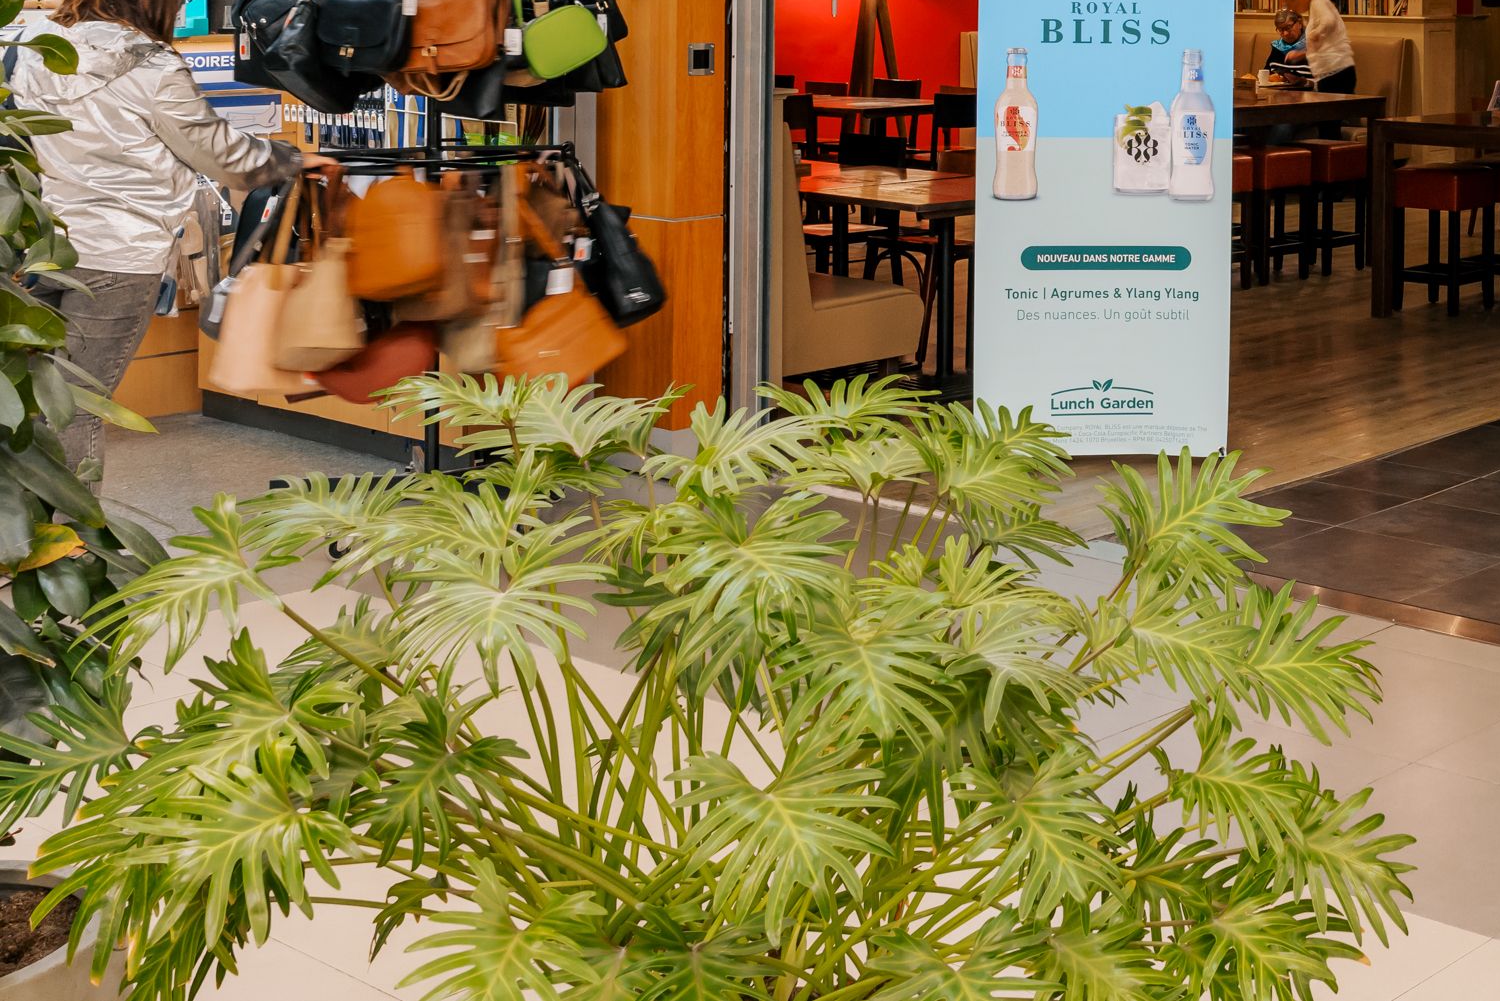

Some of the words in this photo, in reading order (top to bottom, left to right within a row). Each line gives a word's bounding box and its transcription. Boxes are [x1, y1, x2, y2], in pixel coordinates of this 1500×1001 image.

[1071, 1, 1141, 15] ROYAL
[1040, 18, 1171, 45] BLISS
[1000, 120, 1032, 128] BLISS
[1178, 131, 1209, 139] LISS
[1037, 254, 1081, 263] NOUVEAU
[1082, 254, 1108, 263] DANS
[1110, 254, 1140, 263] NOTRE
[1142, 254, 1176, 263] GAMME
[1005, 288, 1038, 299] Tonic
[1051, 288, 1109, 301] Agrumes
[1113, 288, 1122, 299] &
[1126, 288, 1161, 301] Ylang
[1165, 288, 1199, 302] Ylang
[1016, 309, 1040, 321] Des
[1044, 311, 1100, 320] nuances.
[1104, 309, 1120, 320] Un
[1124, 308, 1152, 323] goût
[1155, 309, 1190, 321] subtil
[1051, 398, 1095, 410] Lunch
[1100, 397, 1154, 409] Garden
